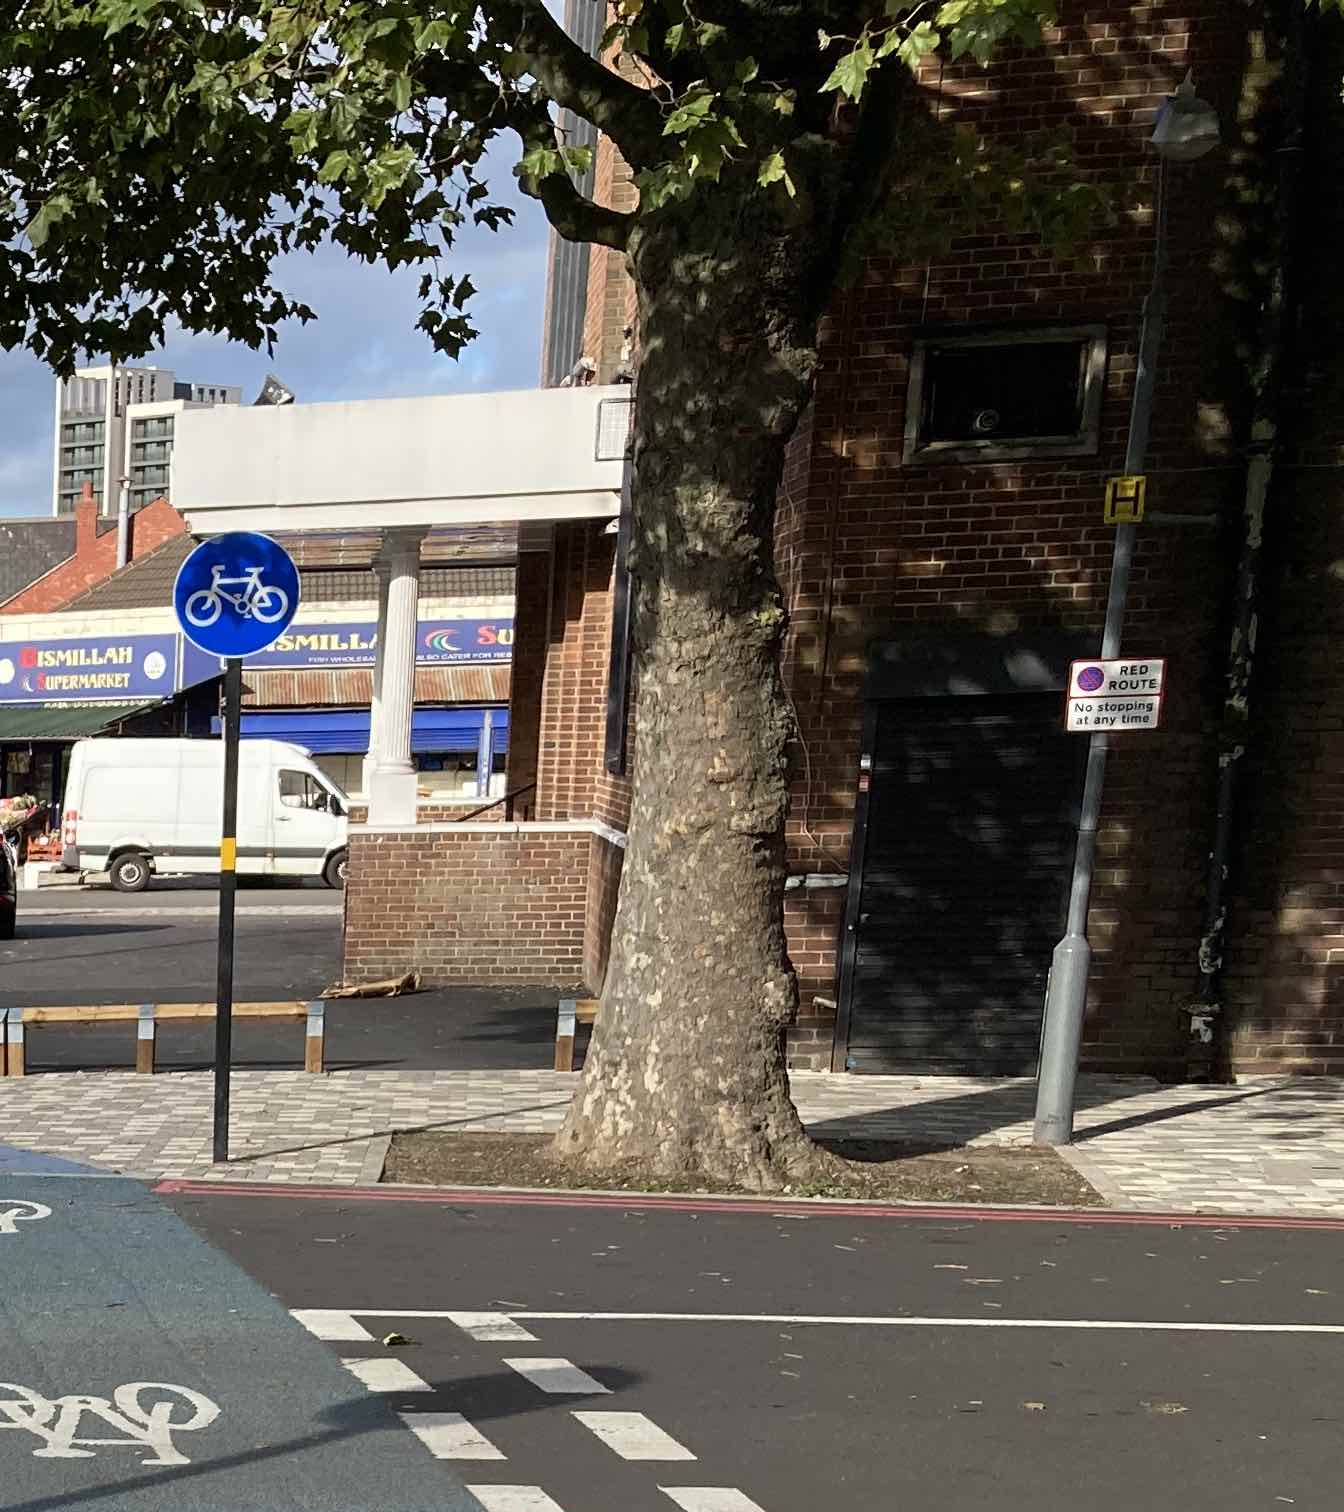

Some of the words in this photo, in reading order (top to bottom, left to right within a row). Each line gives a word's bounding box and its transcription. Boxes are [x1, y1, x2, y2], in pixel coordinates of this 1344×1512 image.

[1110, 481, 1140, 518] H
[266, 633, 376, 652] SMILL
[1120, 665, 1149, 676] RED
[1108, 678, 1157, 691] ROUTE
[1074, 703, 1093, 712] No
[1097, 701, 1154, 713] stopping
[1076, 715, 1089, 725] at
[1093, 715, 1117, 727] any
[1121, 714, 1150, 724] time
